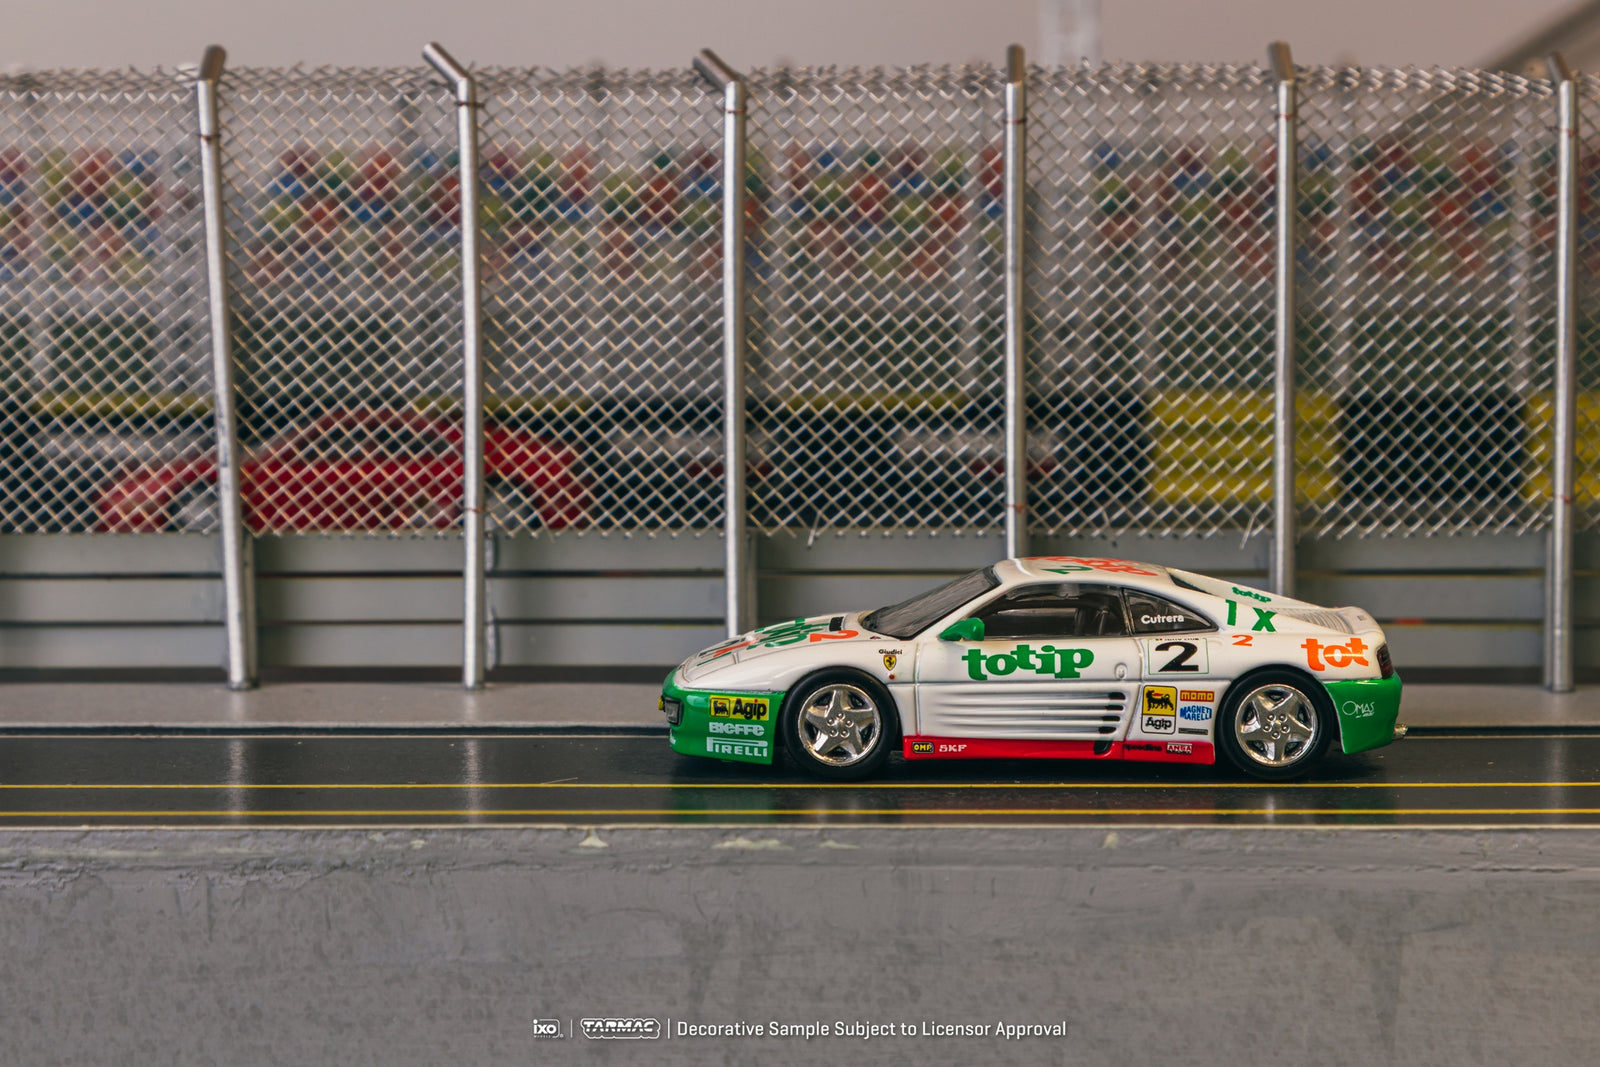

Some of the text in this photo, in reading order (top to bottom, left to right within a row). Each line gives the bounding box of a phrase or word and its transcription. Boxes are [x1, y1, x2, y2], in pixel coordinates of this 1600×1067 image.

[1141, 614, 1185, 624] Cutrera
[1231, 634, 1253, 646] 2
[1155, 641, 1199, 672] 2
[1301, 637, 1369, 671] tot
[961, 644, 1095, 681] totip
[733, 698, 767, 719] Agip
[1342, 700, 1375, 715] OMAS
[1145, 717, 1172, 730] Agip
[706, 737, 768, 757] PIRELLI
[913, 743, 932, 751] OMP
[939, 744, 967, 752] SKF
